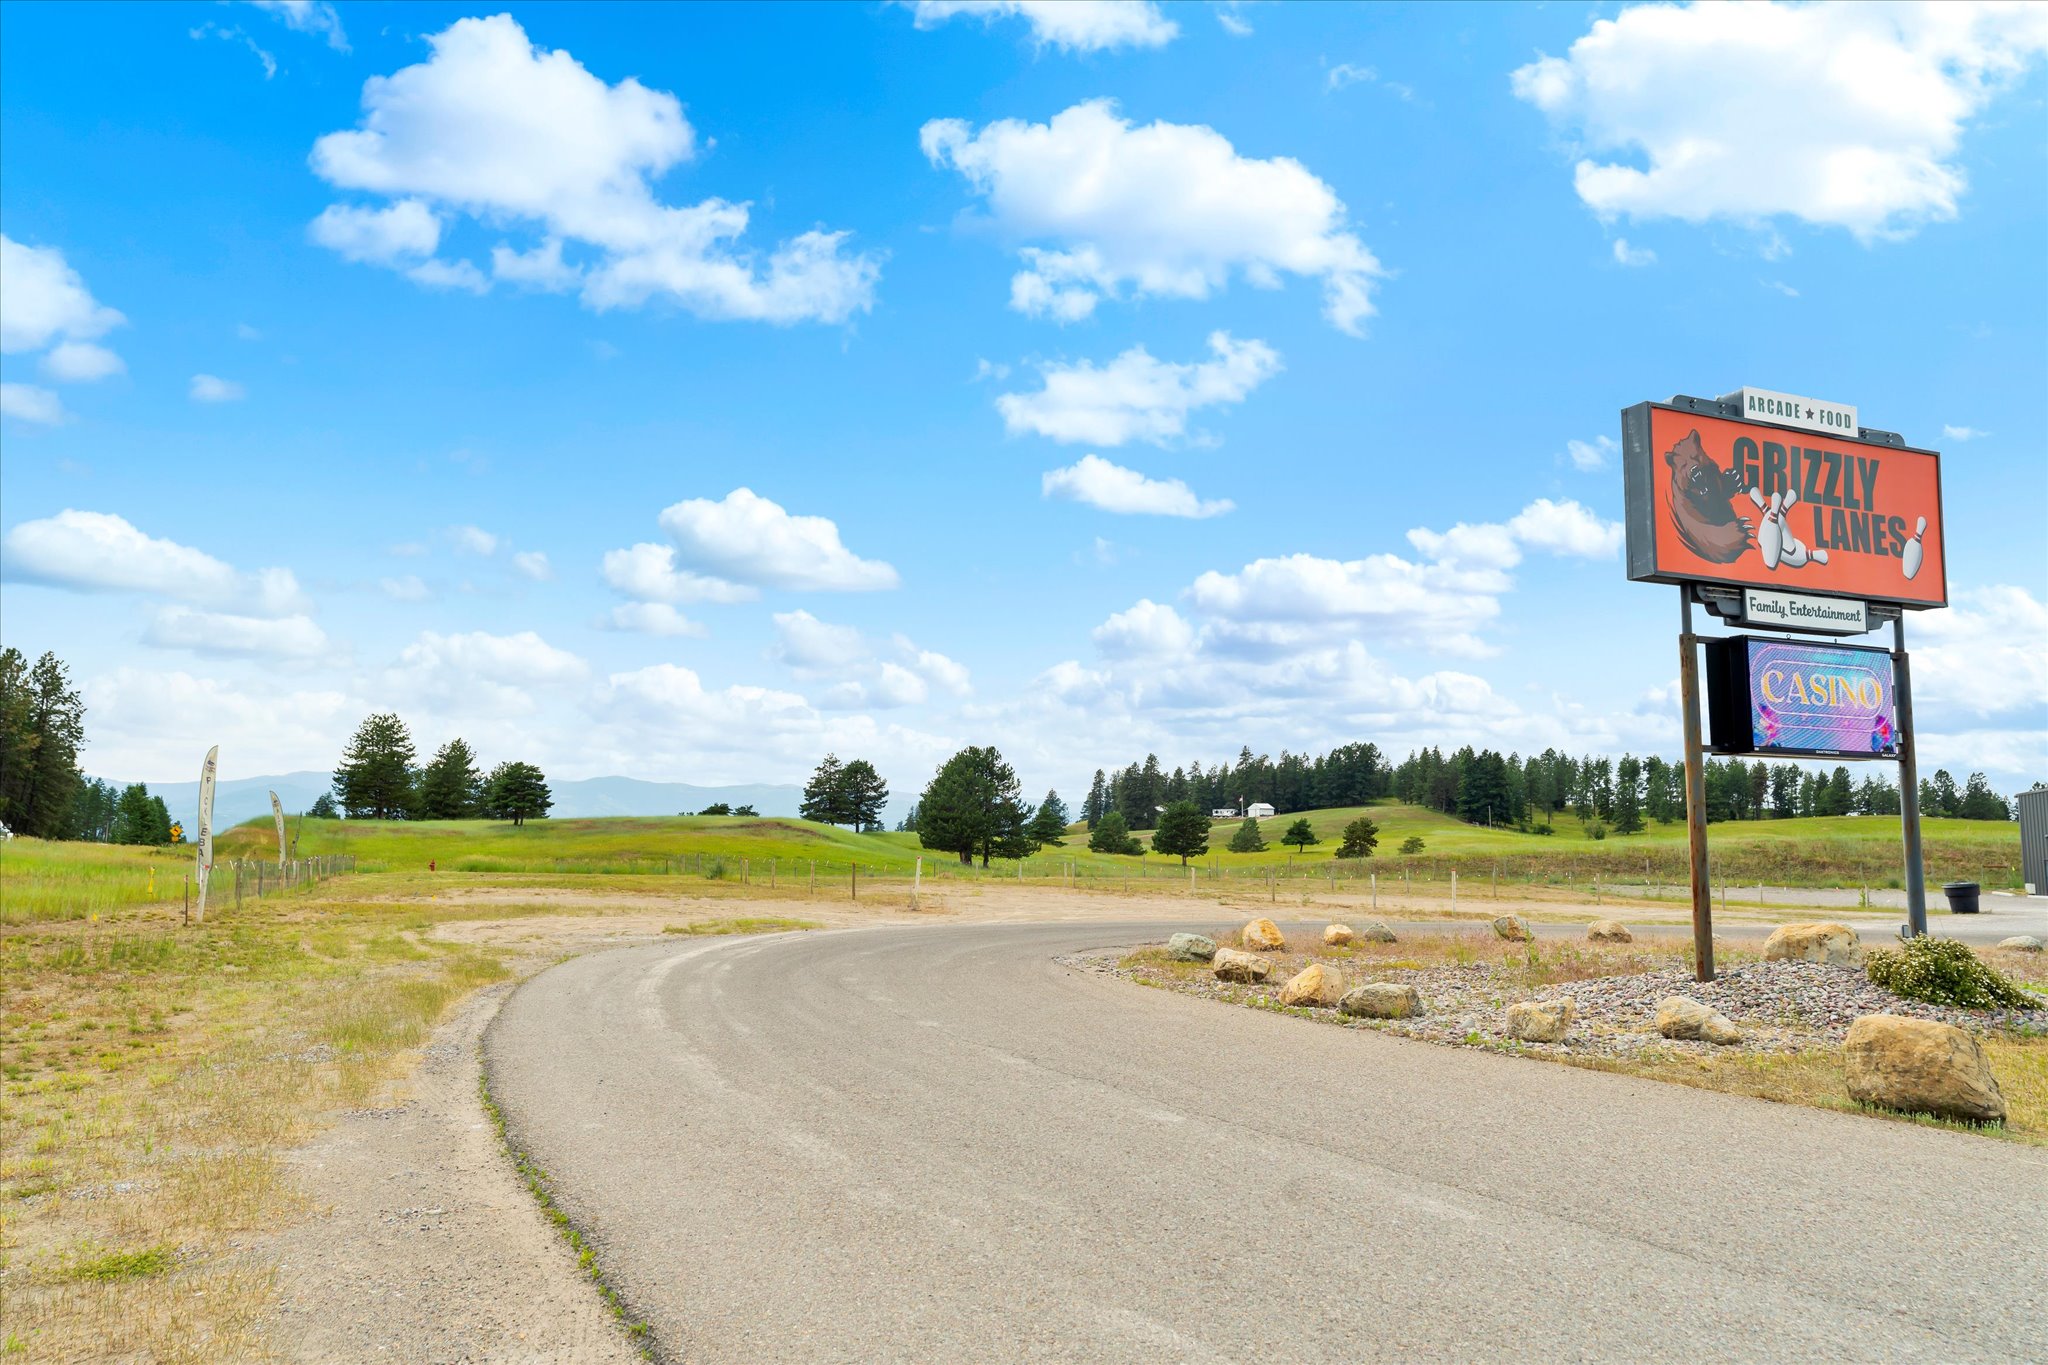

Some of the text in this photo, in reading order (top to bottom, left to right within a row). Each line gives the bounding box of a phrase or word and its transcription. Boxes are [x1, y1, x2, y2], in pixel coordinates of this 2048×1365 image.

[1749, 396, 1851, 429] ARCADE FOOD
[1732, 436, 1880, 513] GRIZZLY
[1813, 506, 1908, 559] LANES
[1749, 597, 1861, 622] Family Entertainment
[1762, 670, 1882, 710] CASINO
